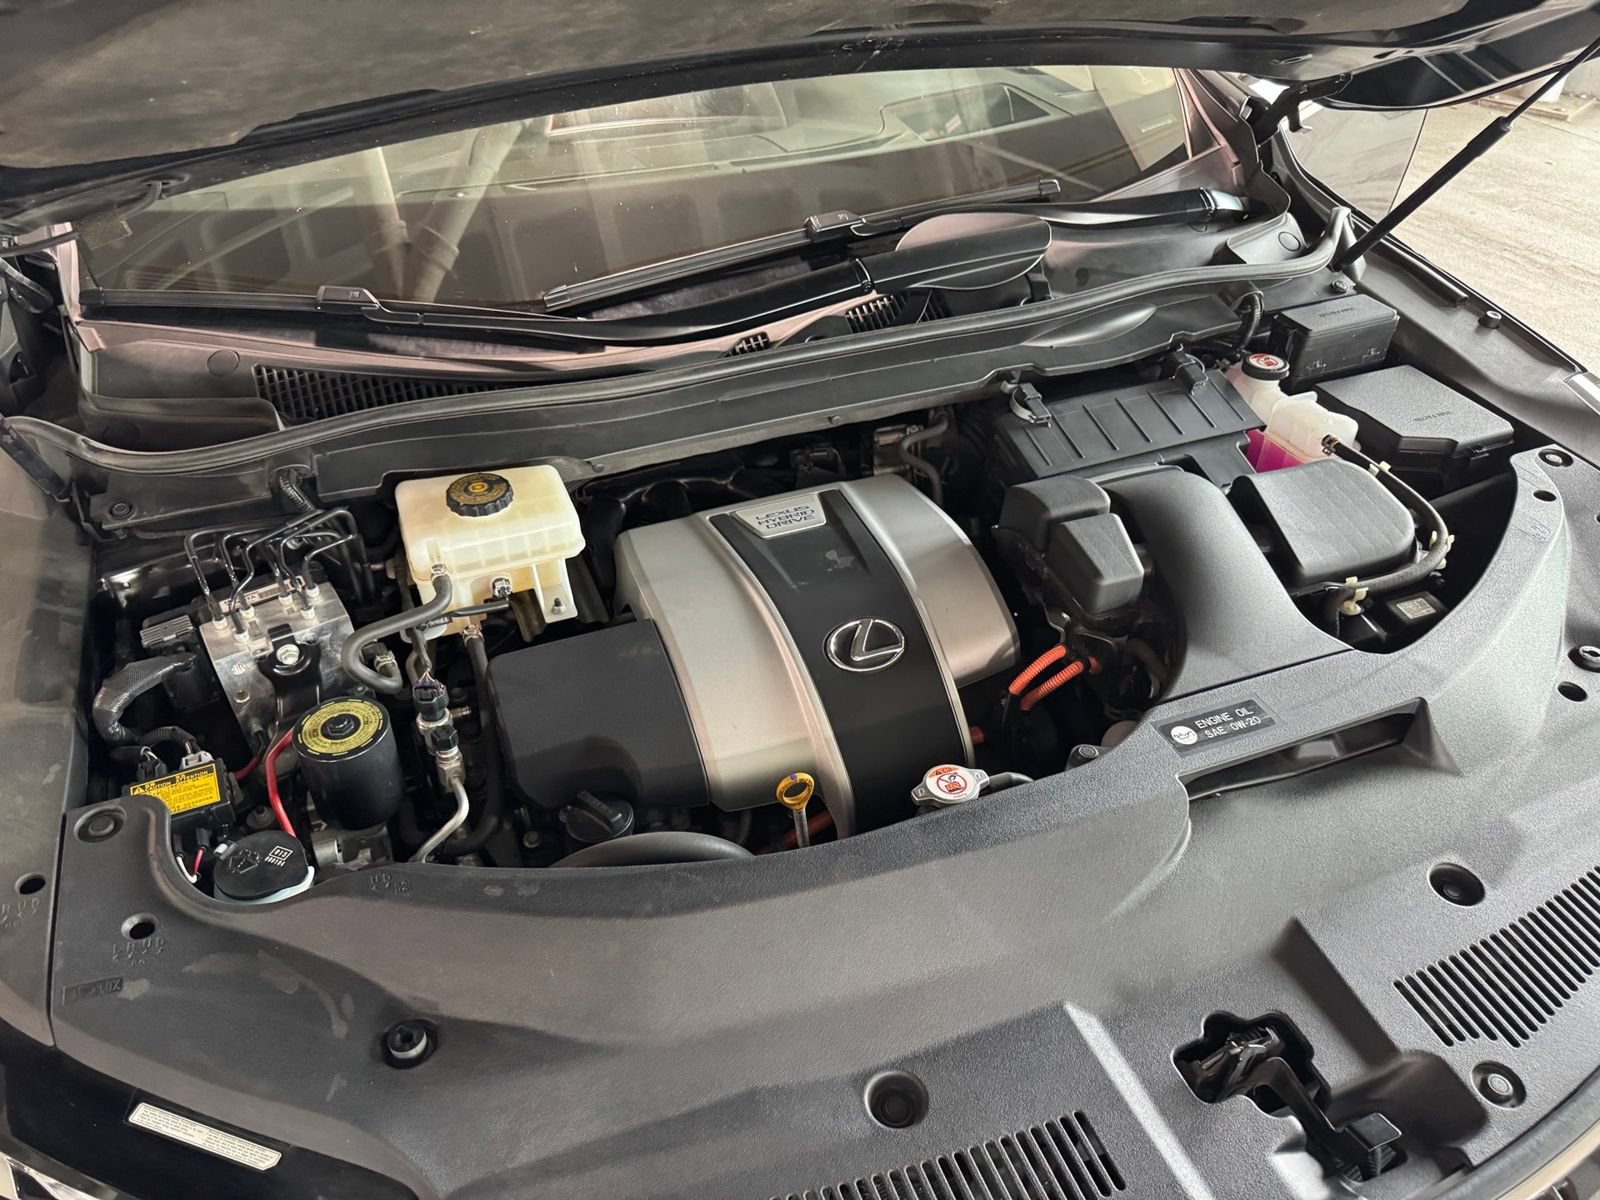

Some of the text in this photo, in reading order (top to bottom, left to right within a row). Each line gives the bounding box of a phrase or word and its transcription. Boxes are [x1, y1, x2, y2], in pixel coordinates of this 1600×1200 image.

[755, 506, 810, 519] LEXUS
[757, 509, 815, 525] HYBRID
[766, 514, 816, 529] DRIVE
[1194, 707, 1255, 729] ENGINE OIL
[1204, 726, 1228, 739] SAE
